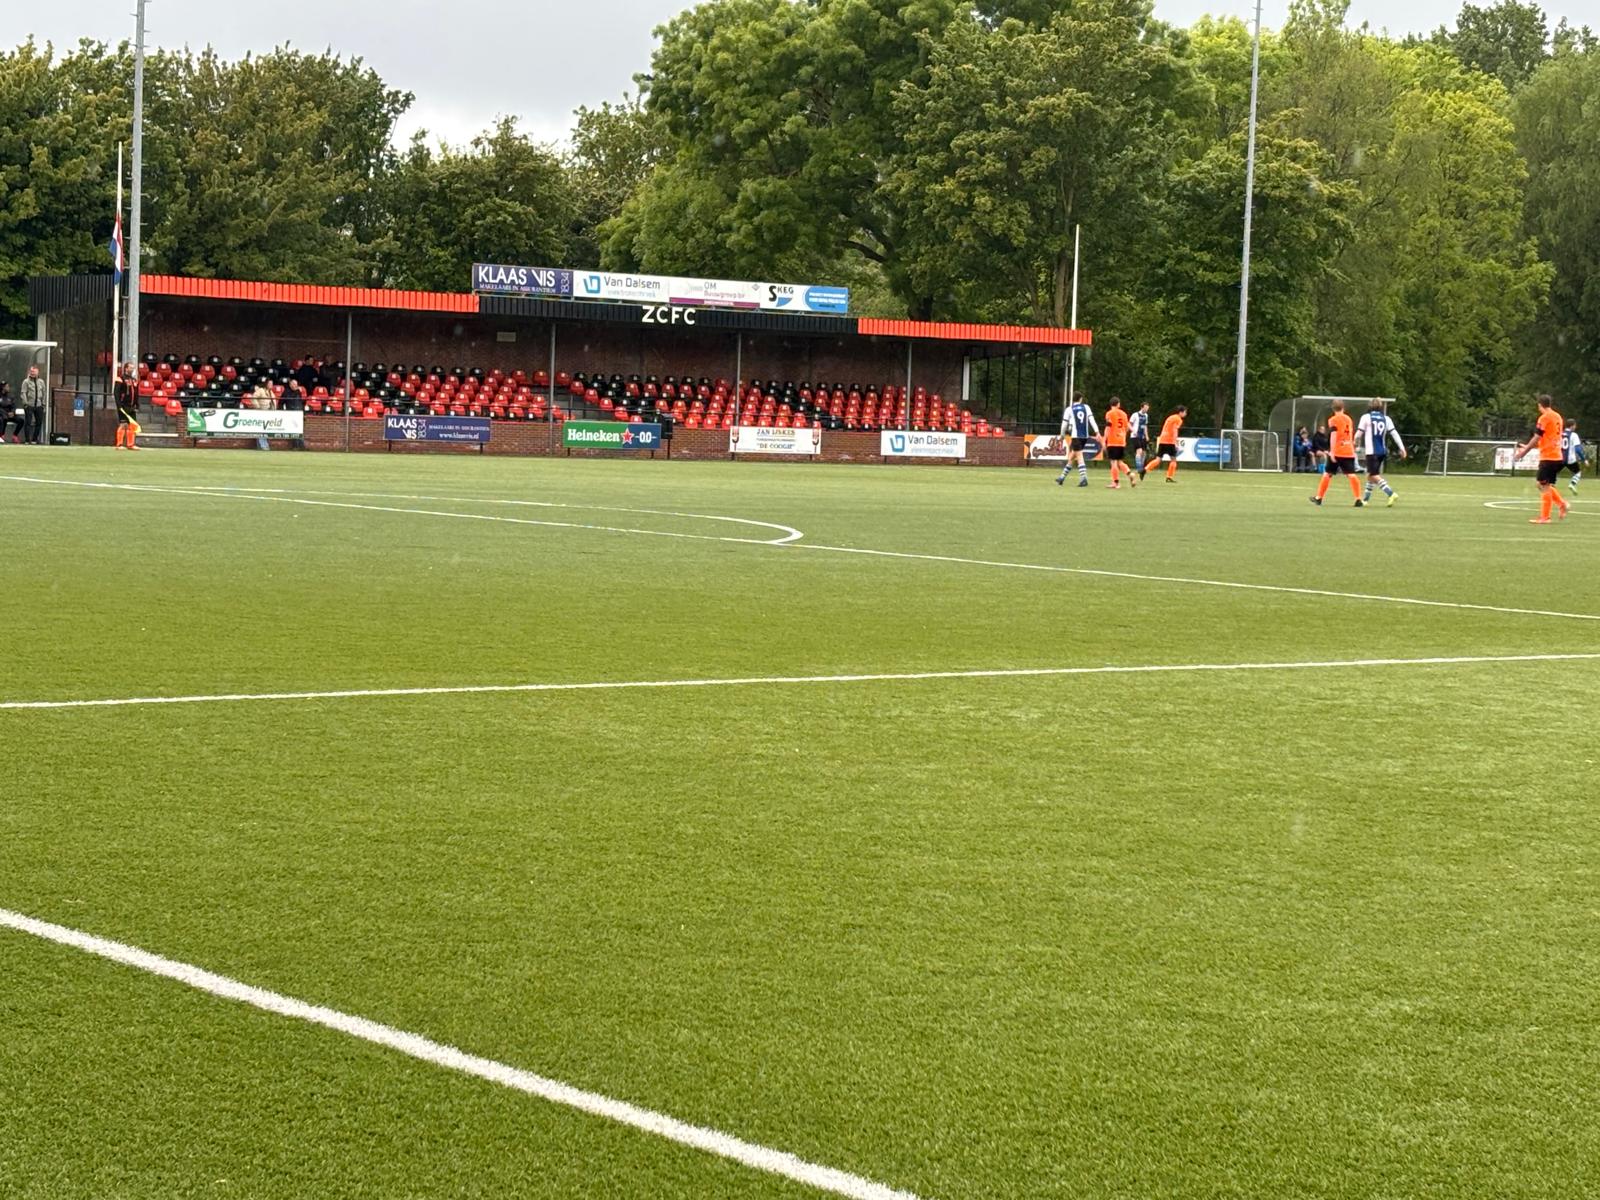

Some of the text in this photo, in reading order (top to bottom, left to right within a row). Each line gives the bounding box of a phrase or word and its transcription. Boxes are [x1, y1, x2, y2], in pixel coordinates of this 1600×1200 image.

[478, 265, 556, 287] KLAAS VIS
[560, 272, 570, 293] 1834
[604, 276, 661, 289] Van Dalsem
[703, 282, 717, 290] OM
[768, 285, 794, 302] SKEG
[641, 304, 696, 325] ZCFC
[222, 411, 283, 431] Groeneveld
[387, 417, 417, 429] KLAAS
[1076, 410, 1084, 424] 9
[1118, 418, 1123, 428] 5
[402, 429, 417, 440] VIS
[417, 419, 427, 439] 1834
[1344, 424, 1350, 436] 4
[1371, 420, 1385, 436] 19
[567, 429, 620, 442] Heineken
[908, 435, 958, 446] Van Dalsem
